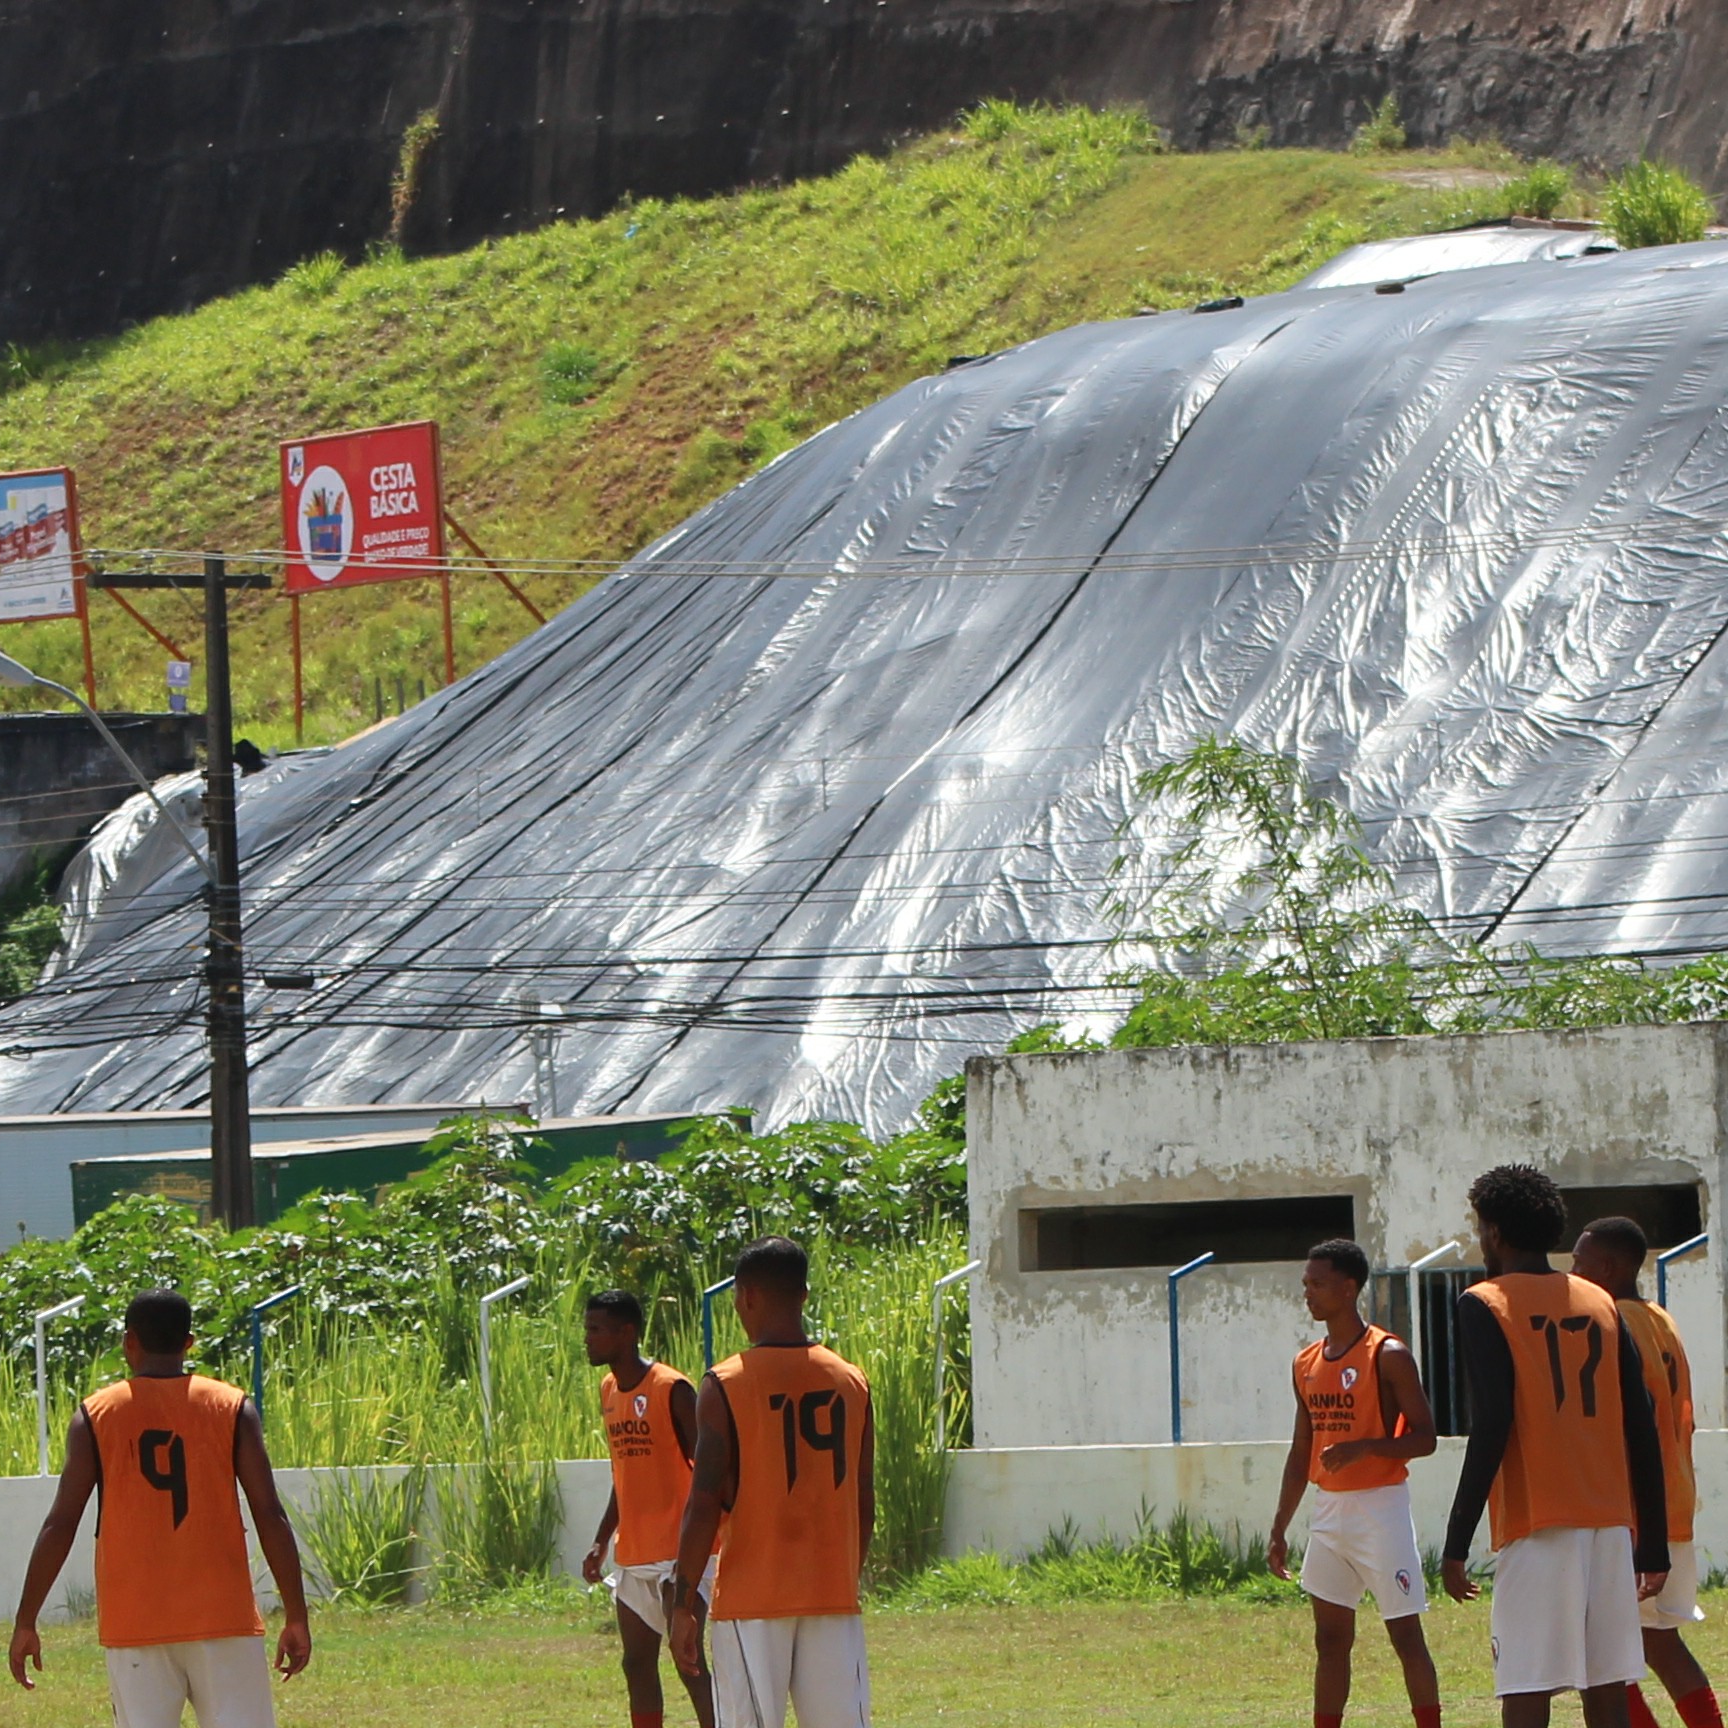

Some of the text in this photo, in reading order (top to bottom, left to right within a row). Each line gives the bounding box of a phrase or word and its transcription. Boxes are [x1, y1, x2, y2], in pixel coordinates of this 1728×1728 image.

[370, 462, 417, 493] CESTA
[370, 491, 419, 519] BÁSICA
[1529, 1314, 1602, 1418] 17
[138, 1428, 189, 1532] 9
[769, 1389, 847, 1496] 19
